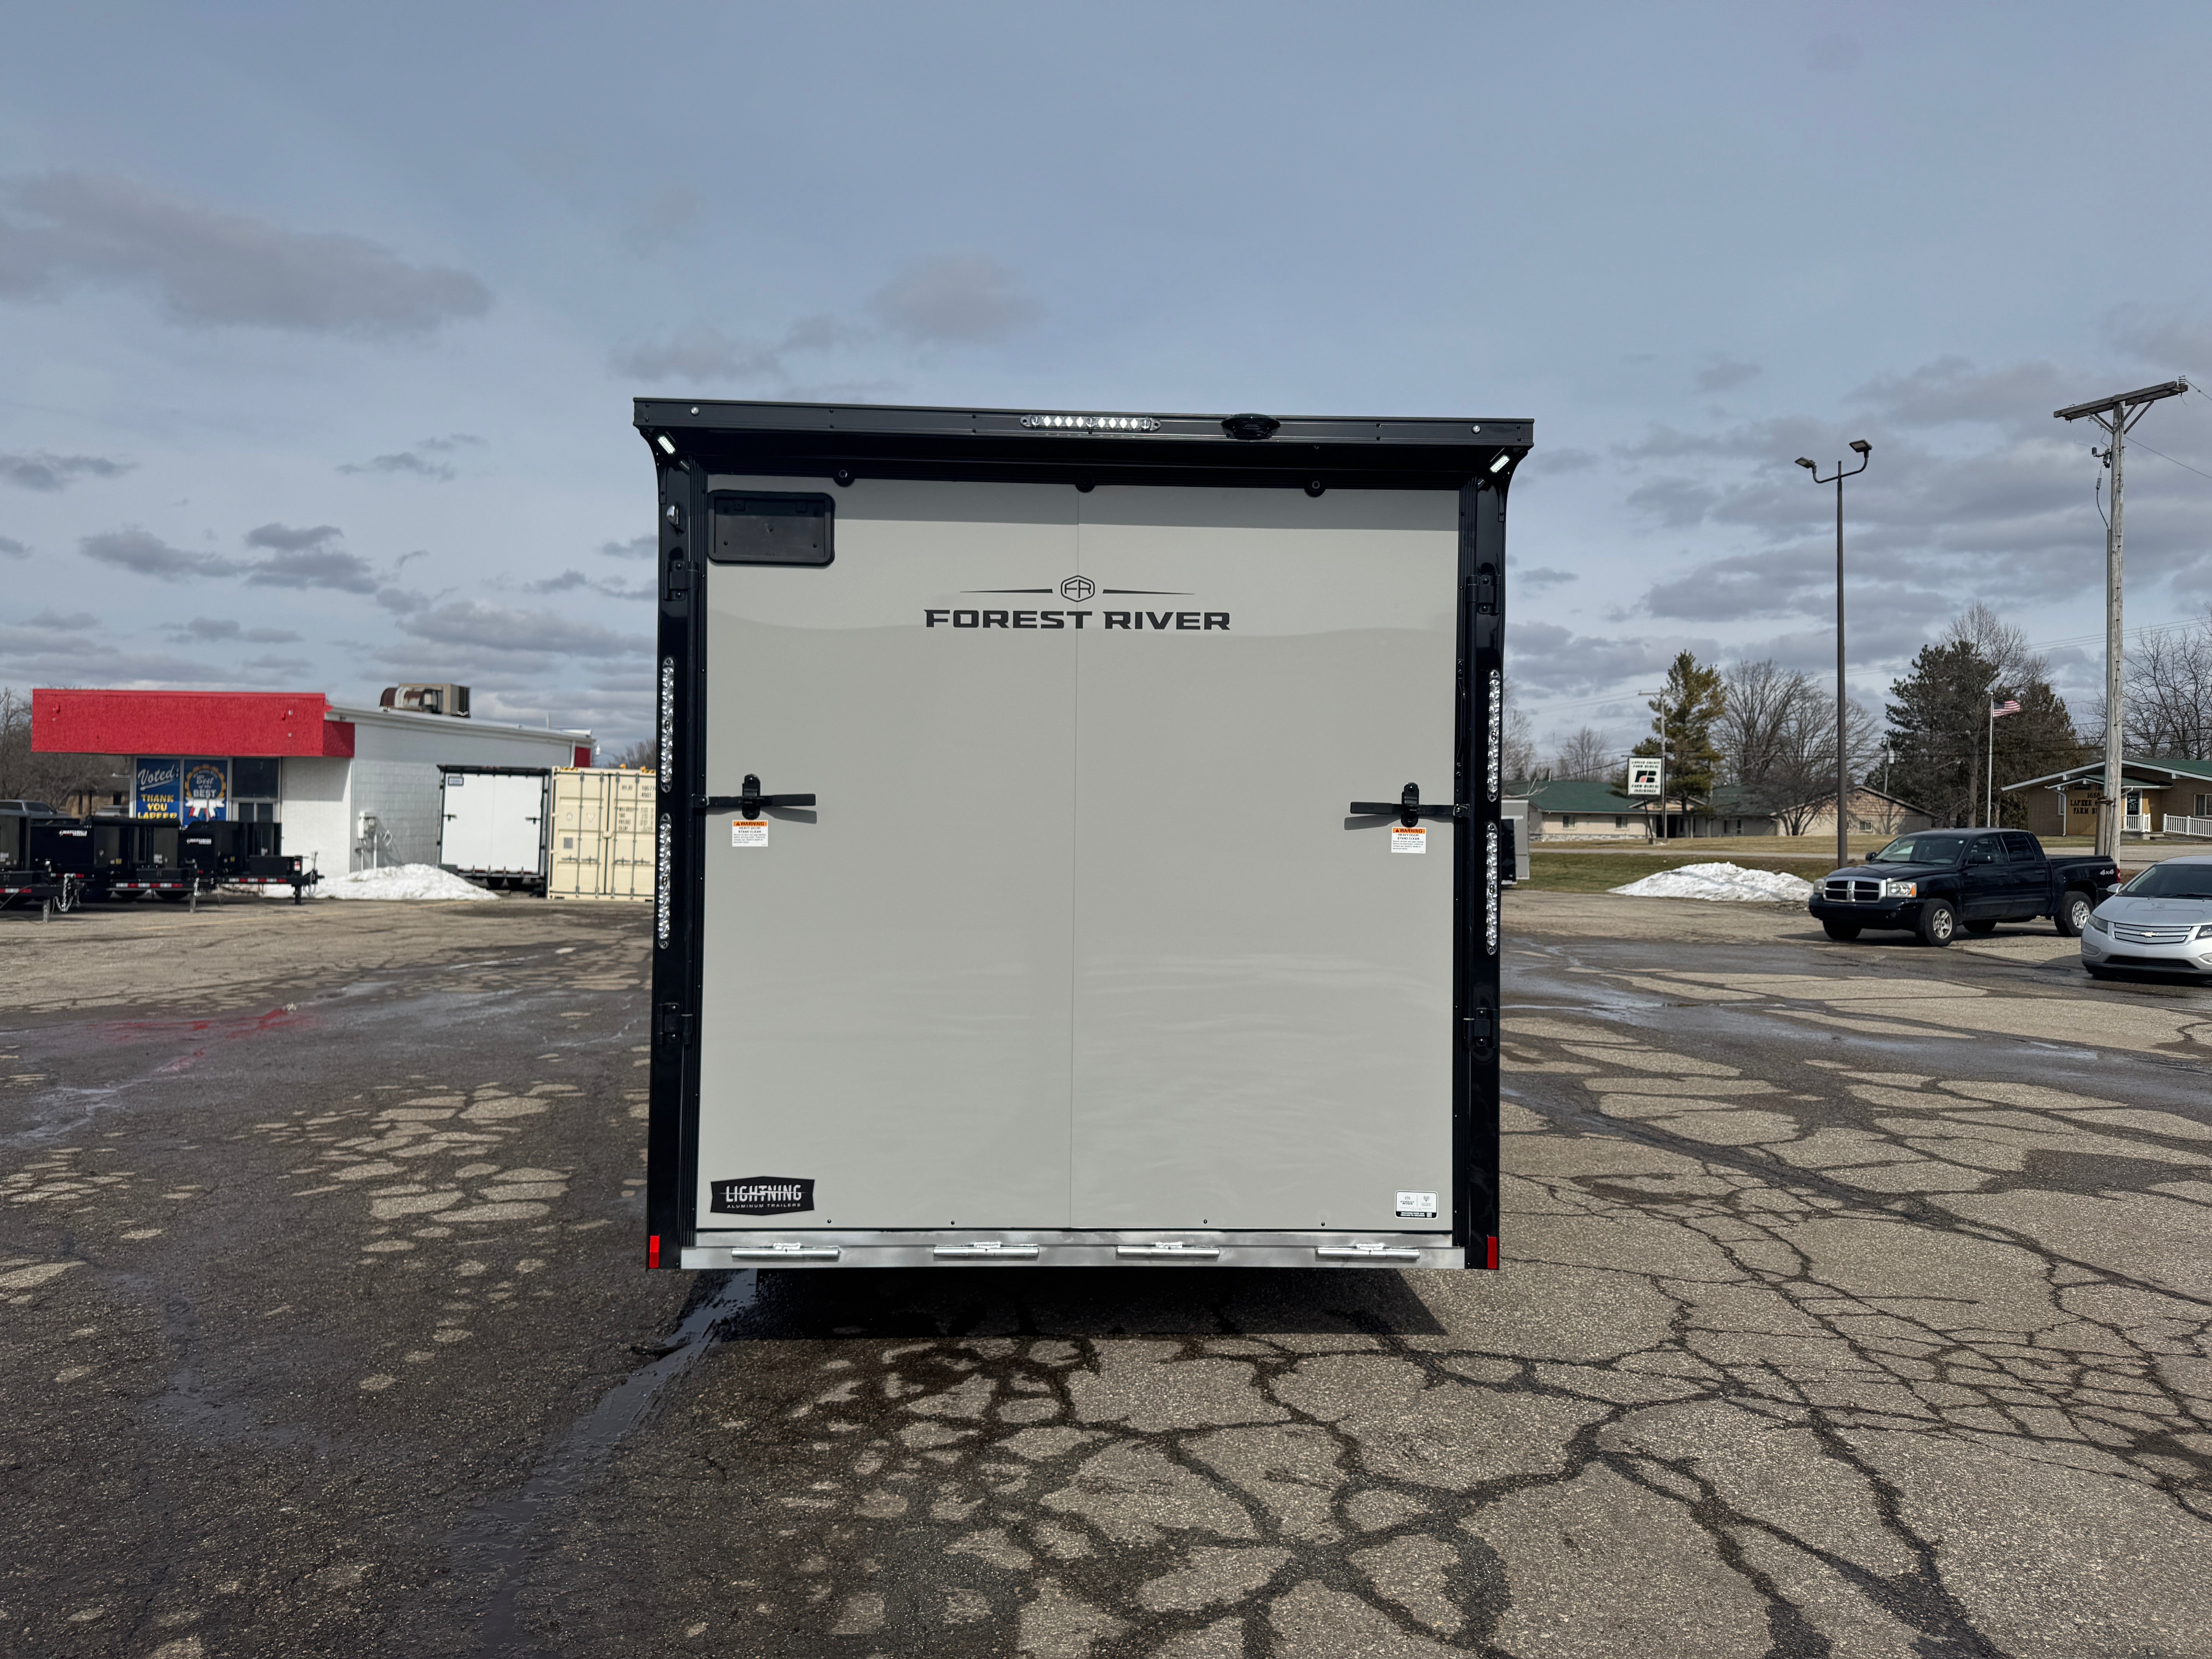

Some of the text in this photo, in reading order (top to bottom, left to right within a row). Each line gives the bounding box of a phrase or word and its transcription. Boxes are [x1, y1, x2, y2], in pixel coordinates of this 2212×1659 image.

[924, 609, 1231, 630] FOREST RIVER
[137, 764, 179, 786] Voted:
[196, 775, 214, 785] Best
[141, 793, 174, 803] THANK
[193, 789, 216, 798] BEST
[147, 803, 168, 812] YOU
[725, 1184, 802, 1202] LIGHTNING
